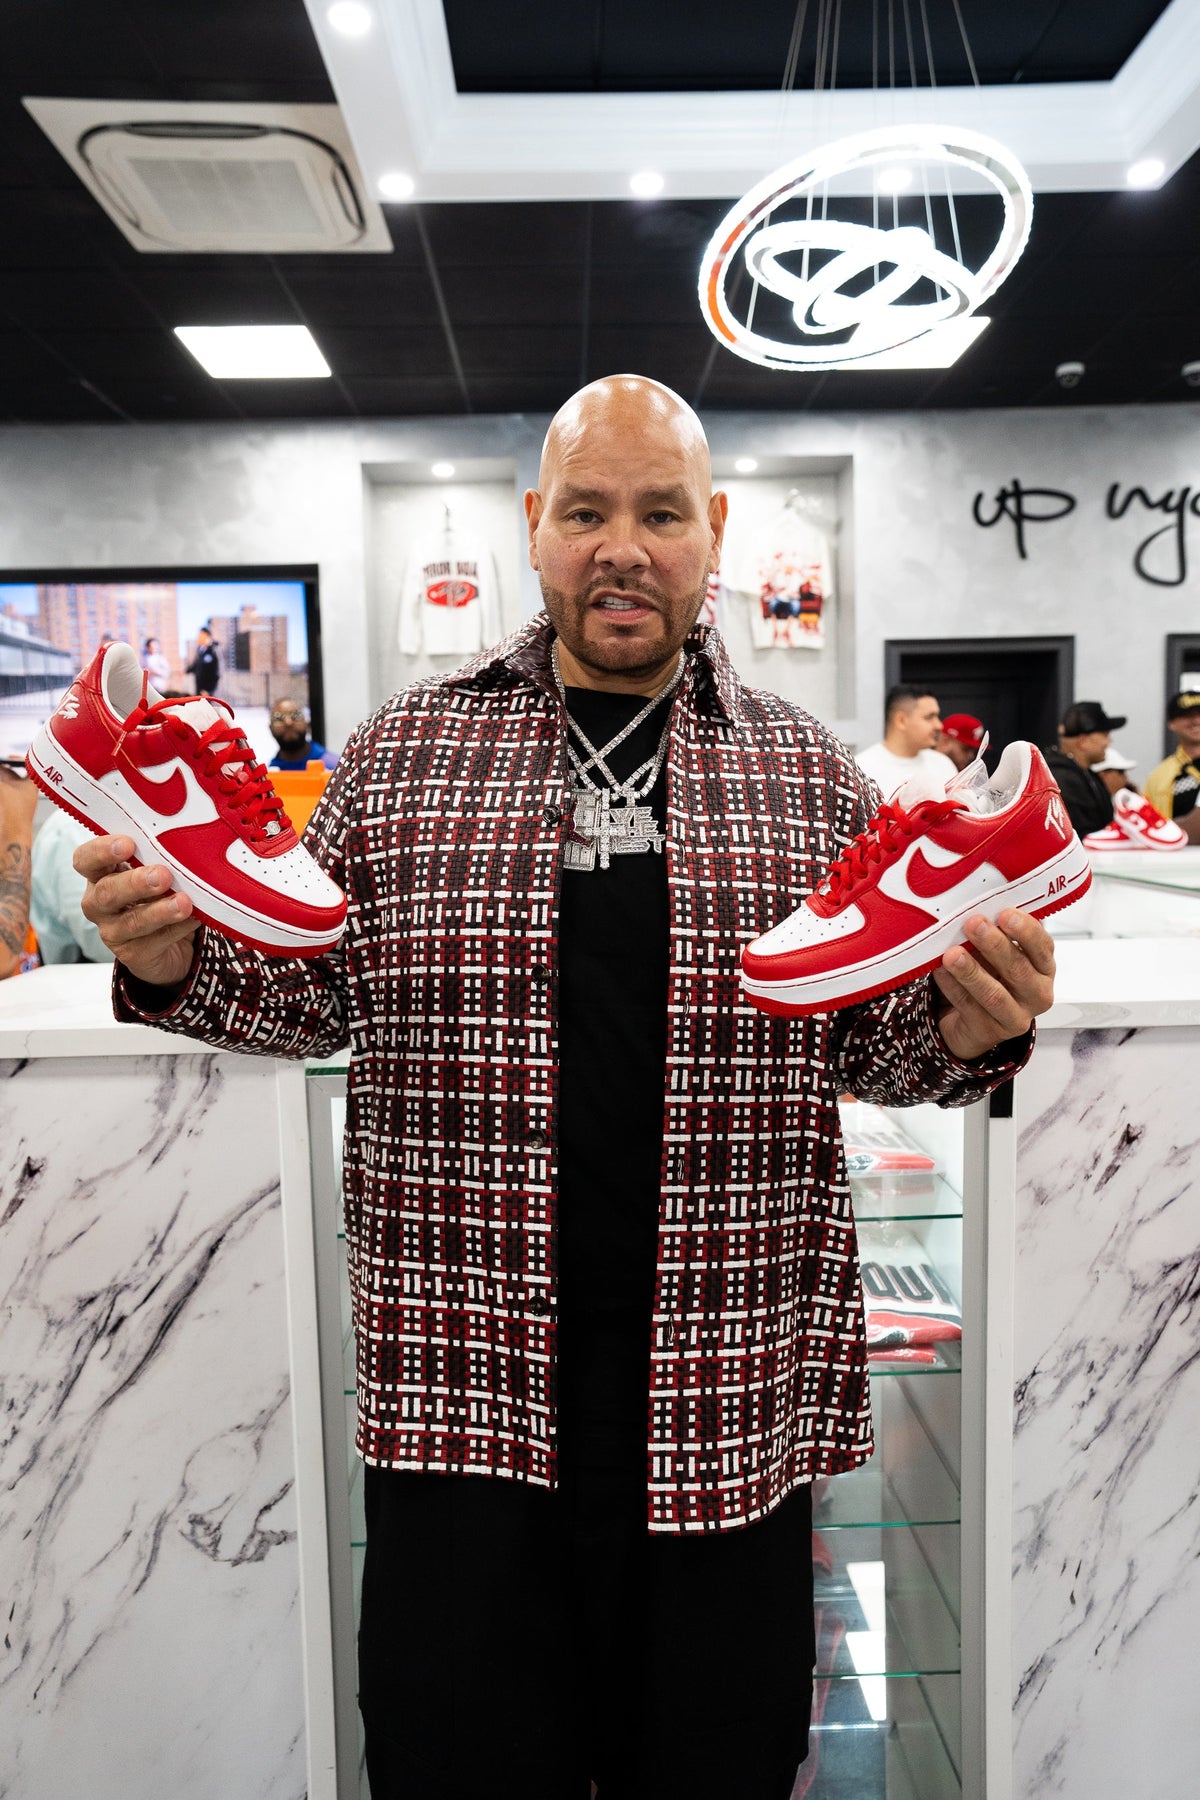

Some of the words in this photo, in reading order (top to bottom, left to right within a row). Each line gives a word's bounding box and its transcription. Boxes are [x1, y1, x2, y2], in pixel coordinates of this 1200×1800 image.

[972, 478, 1077, 560] up
[43, 765, 63, 787] AIR
[1047, 874, 1067, 897] AIR
